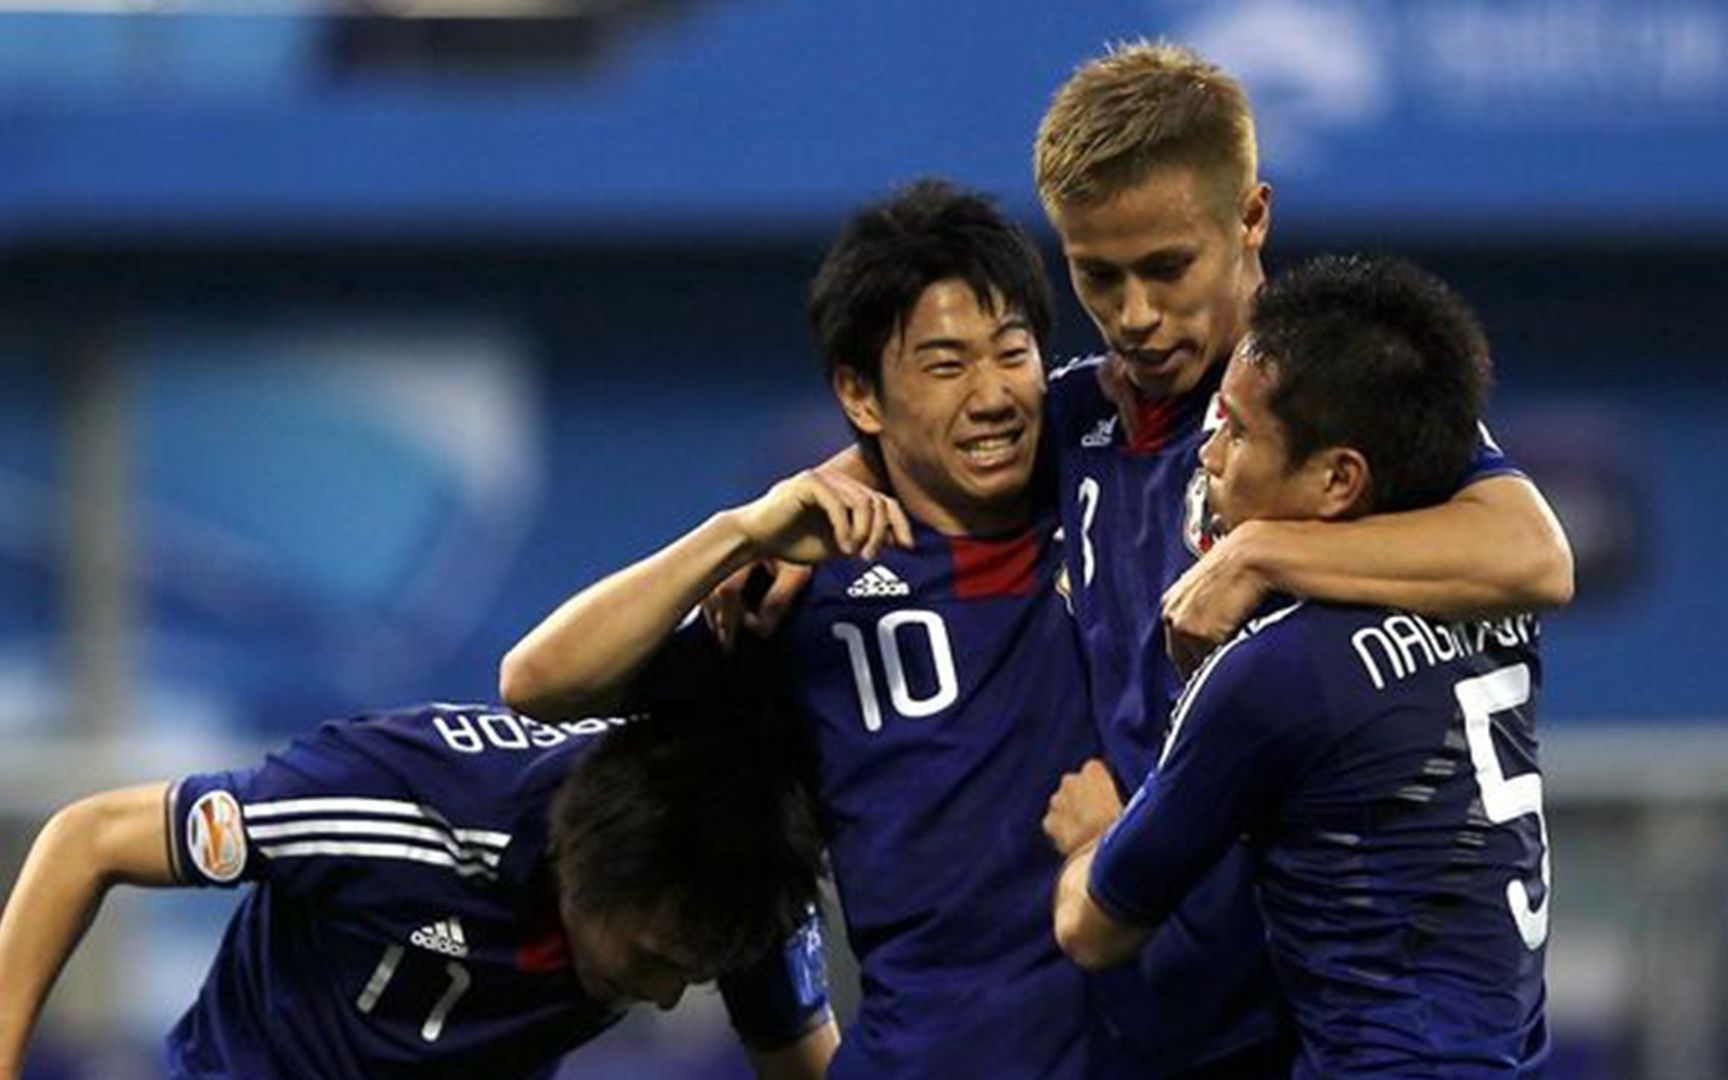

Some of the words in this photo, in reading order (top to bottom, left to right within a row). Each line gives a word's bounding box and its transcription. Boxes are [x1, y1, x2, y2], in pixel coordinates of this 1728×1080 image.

[846, 579, 911, 598] adidas
[830, 608, 960, 732] 10
[432, 713, 627, 752] AEDA
[1453, 662, 1552, 952] 5
